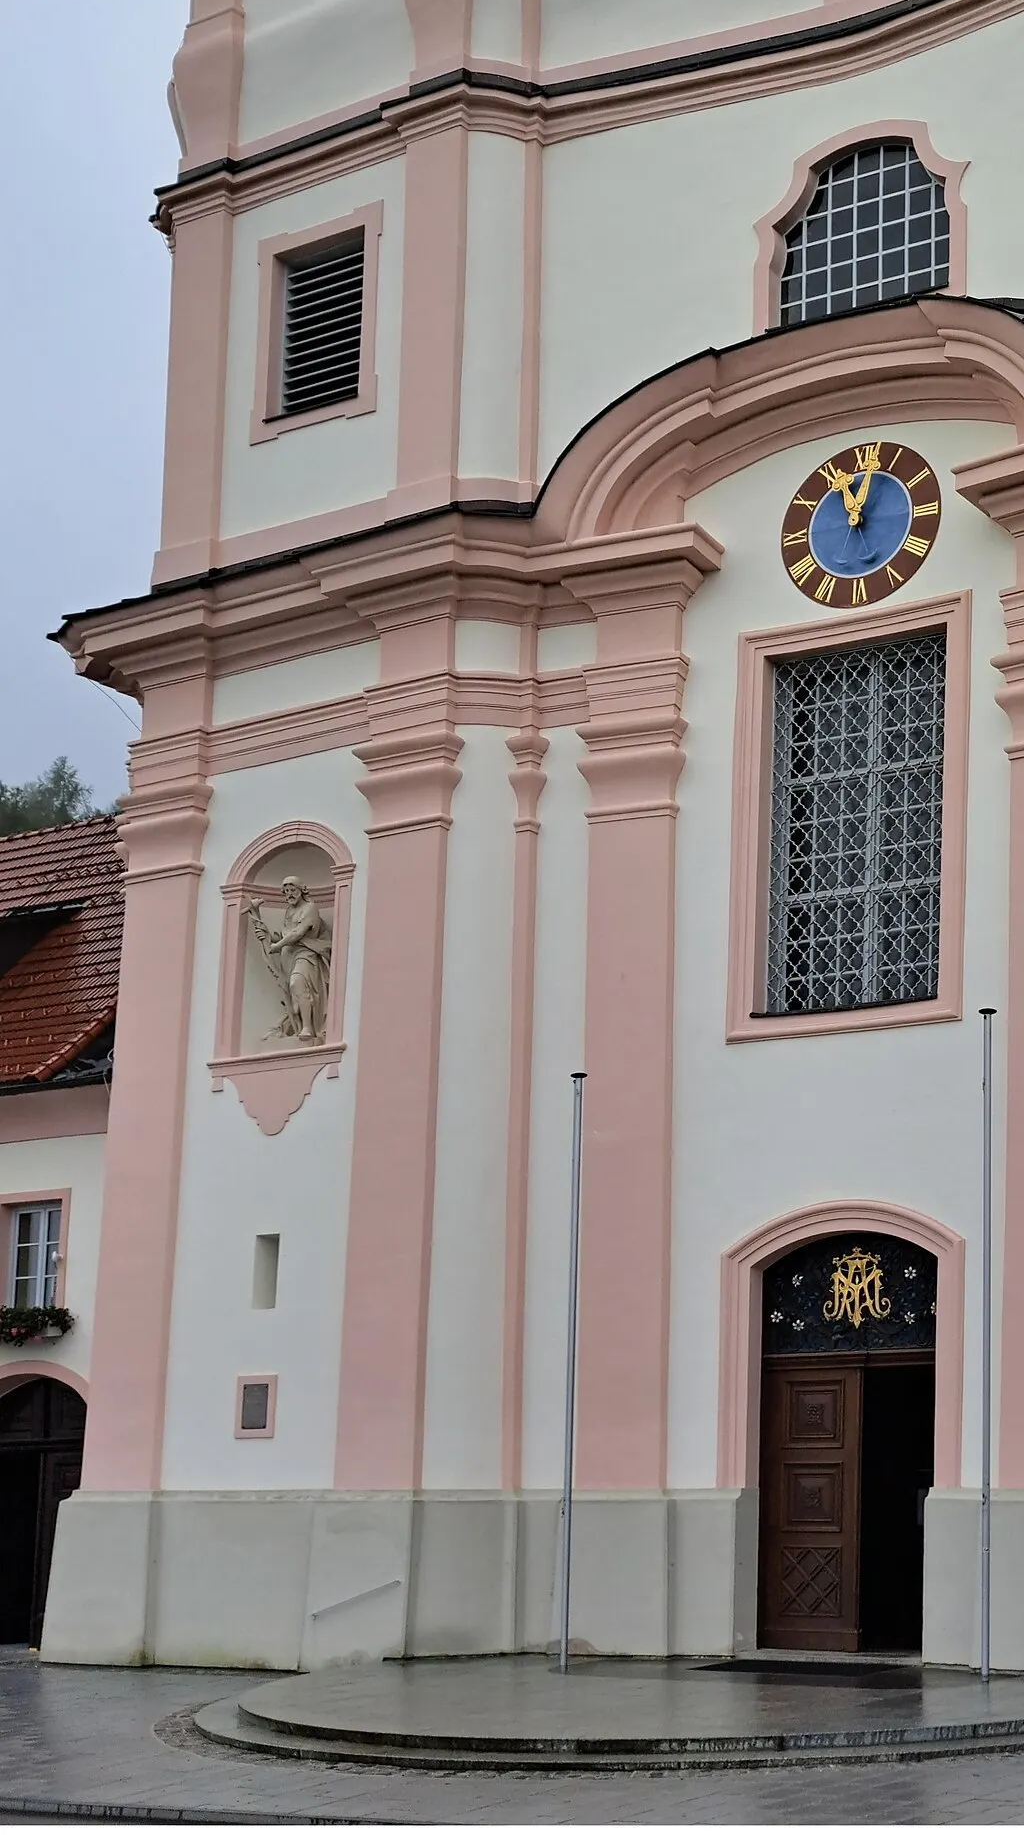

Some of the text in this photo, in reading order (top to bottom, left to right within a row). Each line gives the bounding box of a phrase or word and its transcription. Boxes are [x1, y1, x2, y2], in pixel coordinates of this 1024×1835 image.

[886, 447, 904, 472] I
[905, 466, 932, 490] II
[792, 493, 818, 511] X
[913, 500, 939, 518] III
[782, 527, 808, 548] IX
[902, 533, 932, 559] IIII
[788, 552, 818, 587] VIII
[884, 563, 905, 589] V
[813, 573, 838, 604] VII
[850, 577, 869, 606] VI
